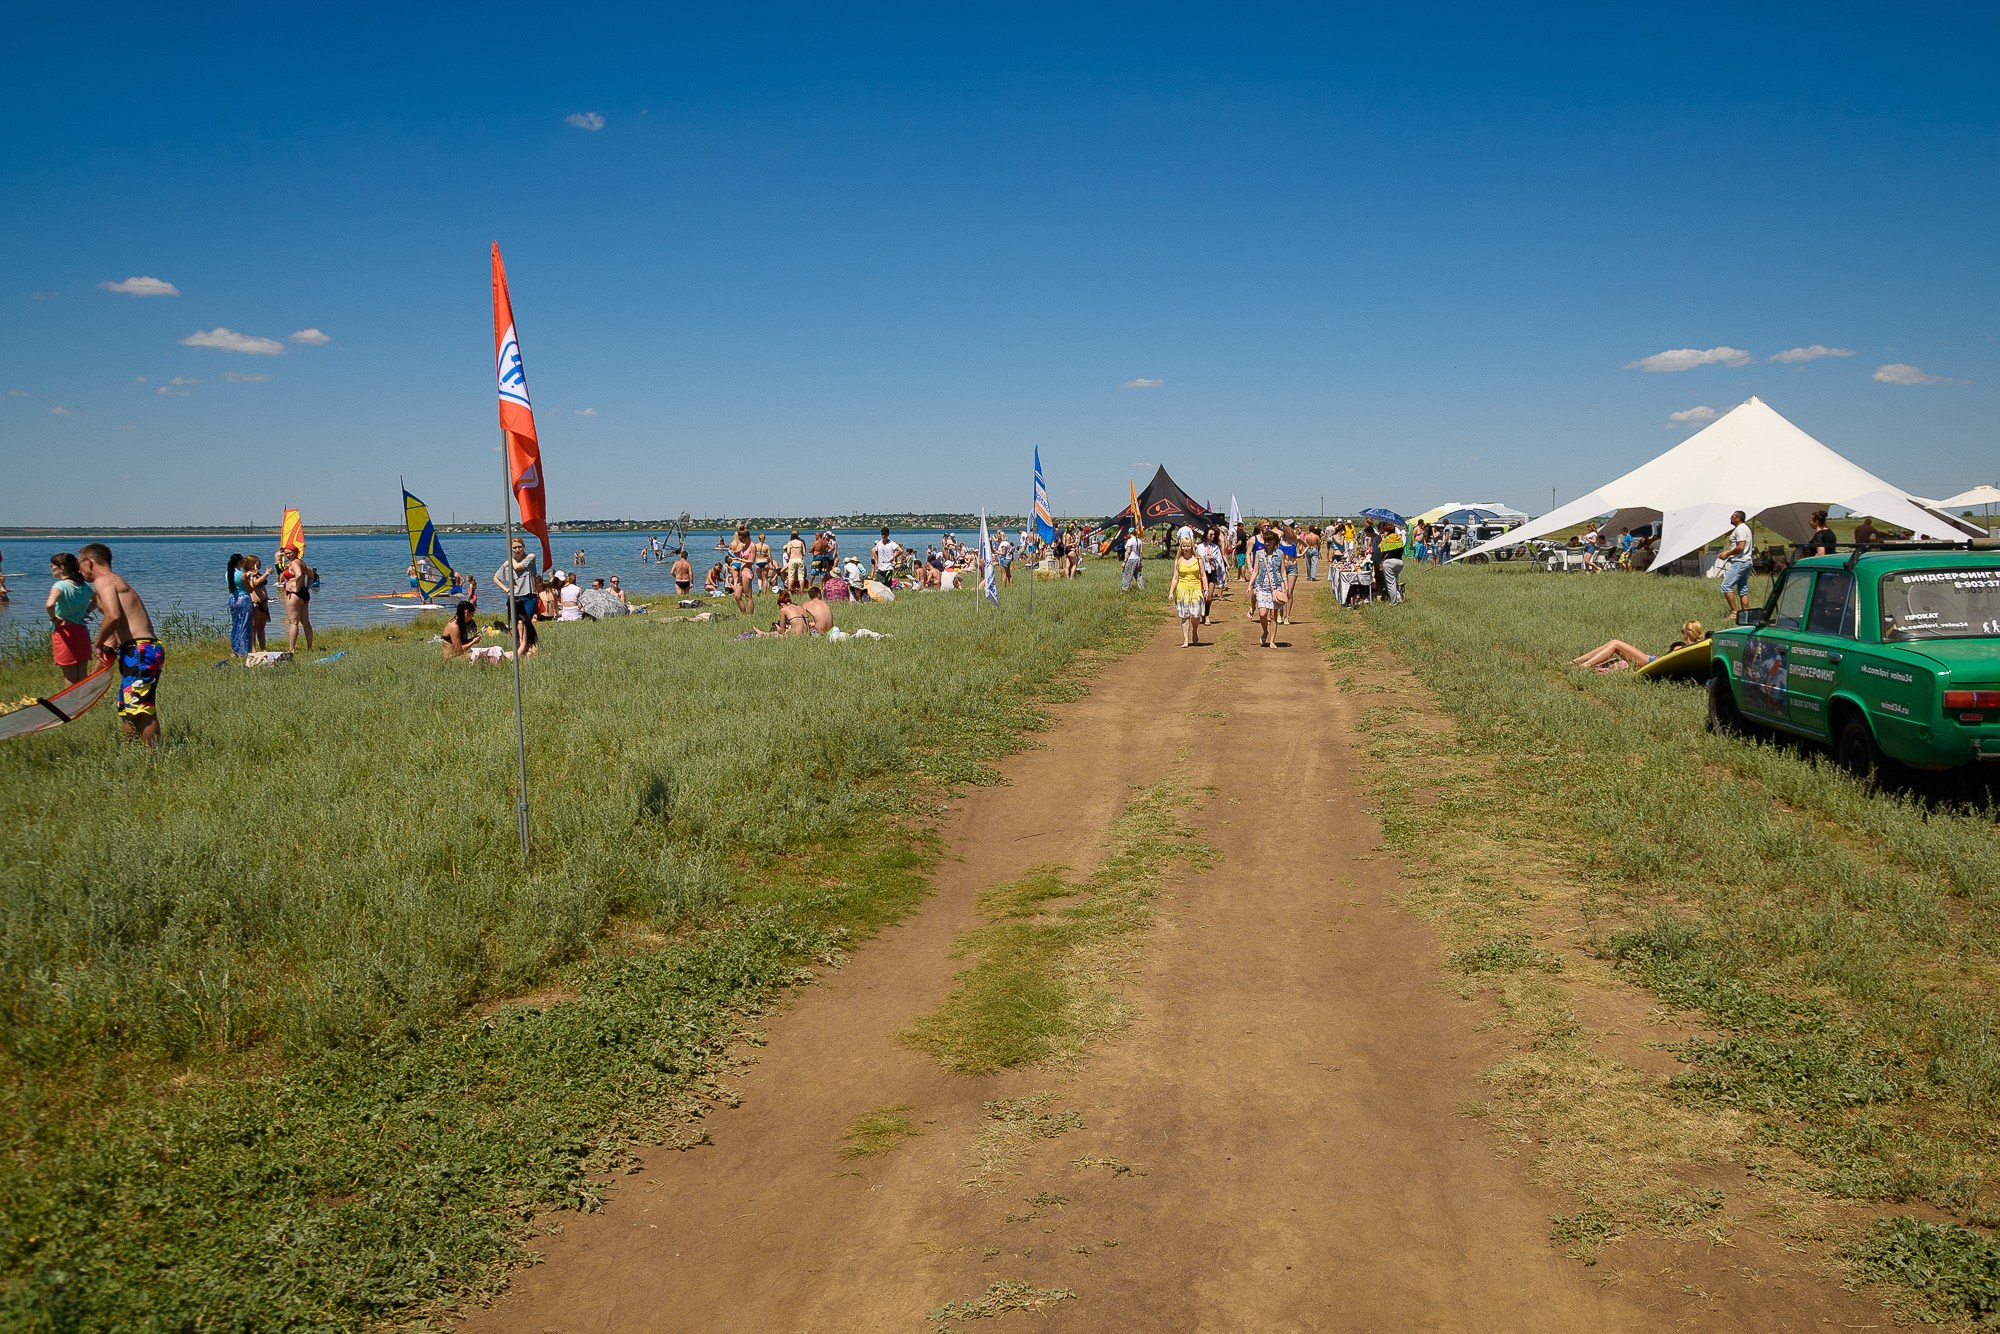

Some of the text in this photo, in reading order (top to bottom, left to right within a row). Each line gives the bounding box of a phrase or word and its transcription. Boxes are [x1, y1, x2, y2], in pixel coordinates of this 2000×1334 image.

[1902, 572, 1992, 584] ВИНДСЕРФИНГ
[1904, 612, 1939, 621] ПРОКАТ
[1789, 663, 1835, 682] ВИНДСЕРФИНГ
[1880, 701, 1909, 715] wind34.ru
